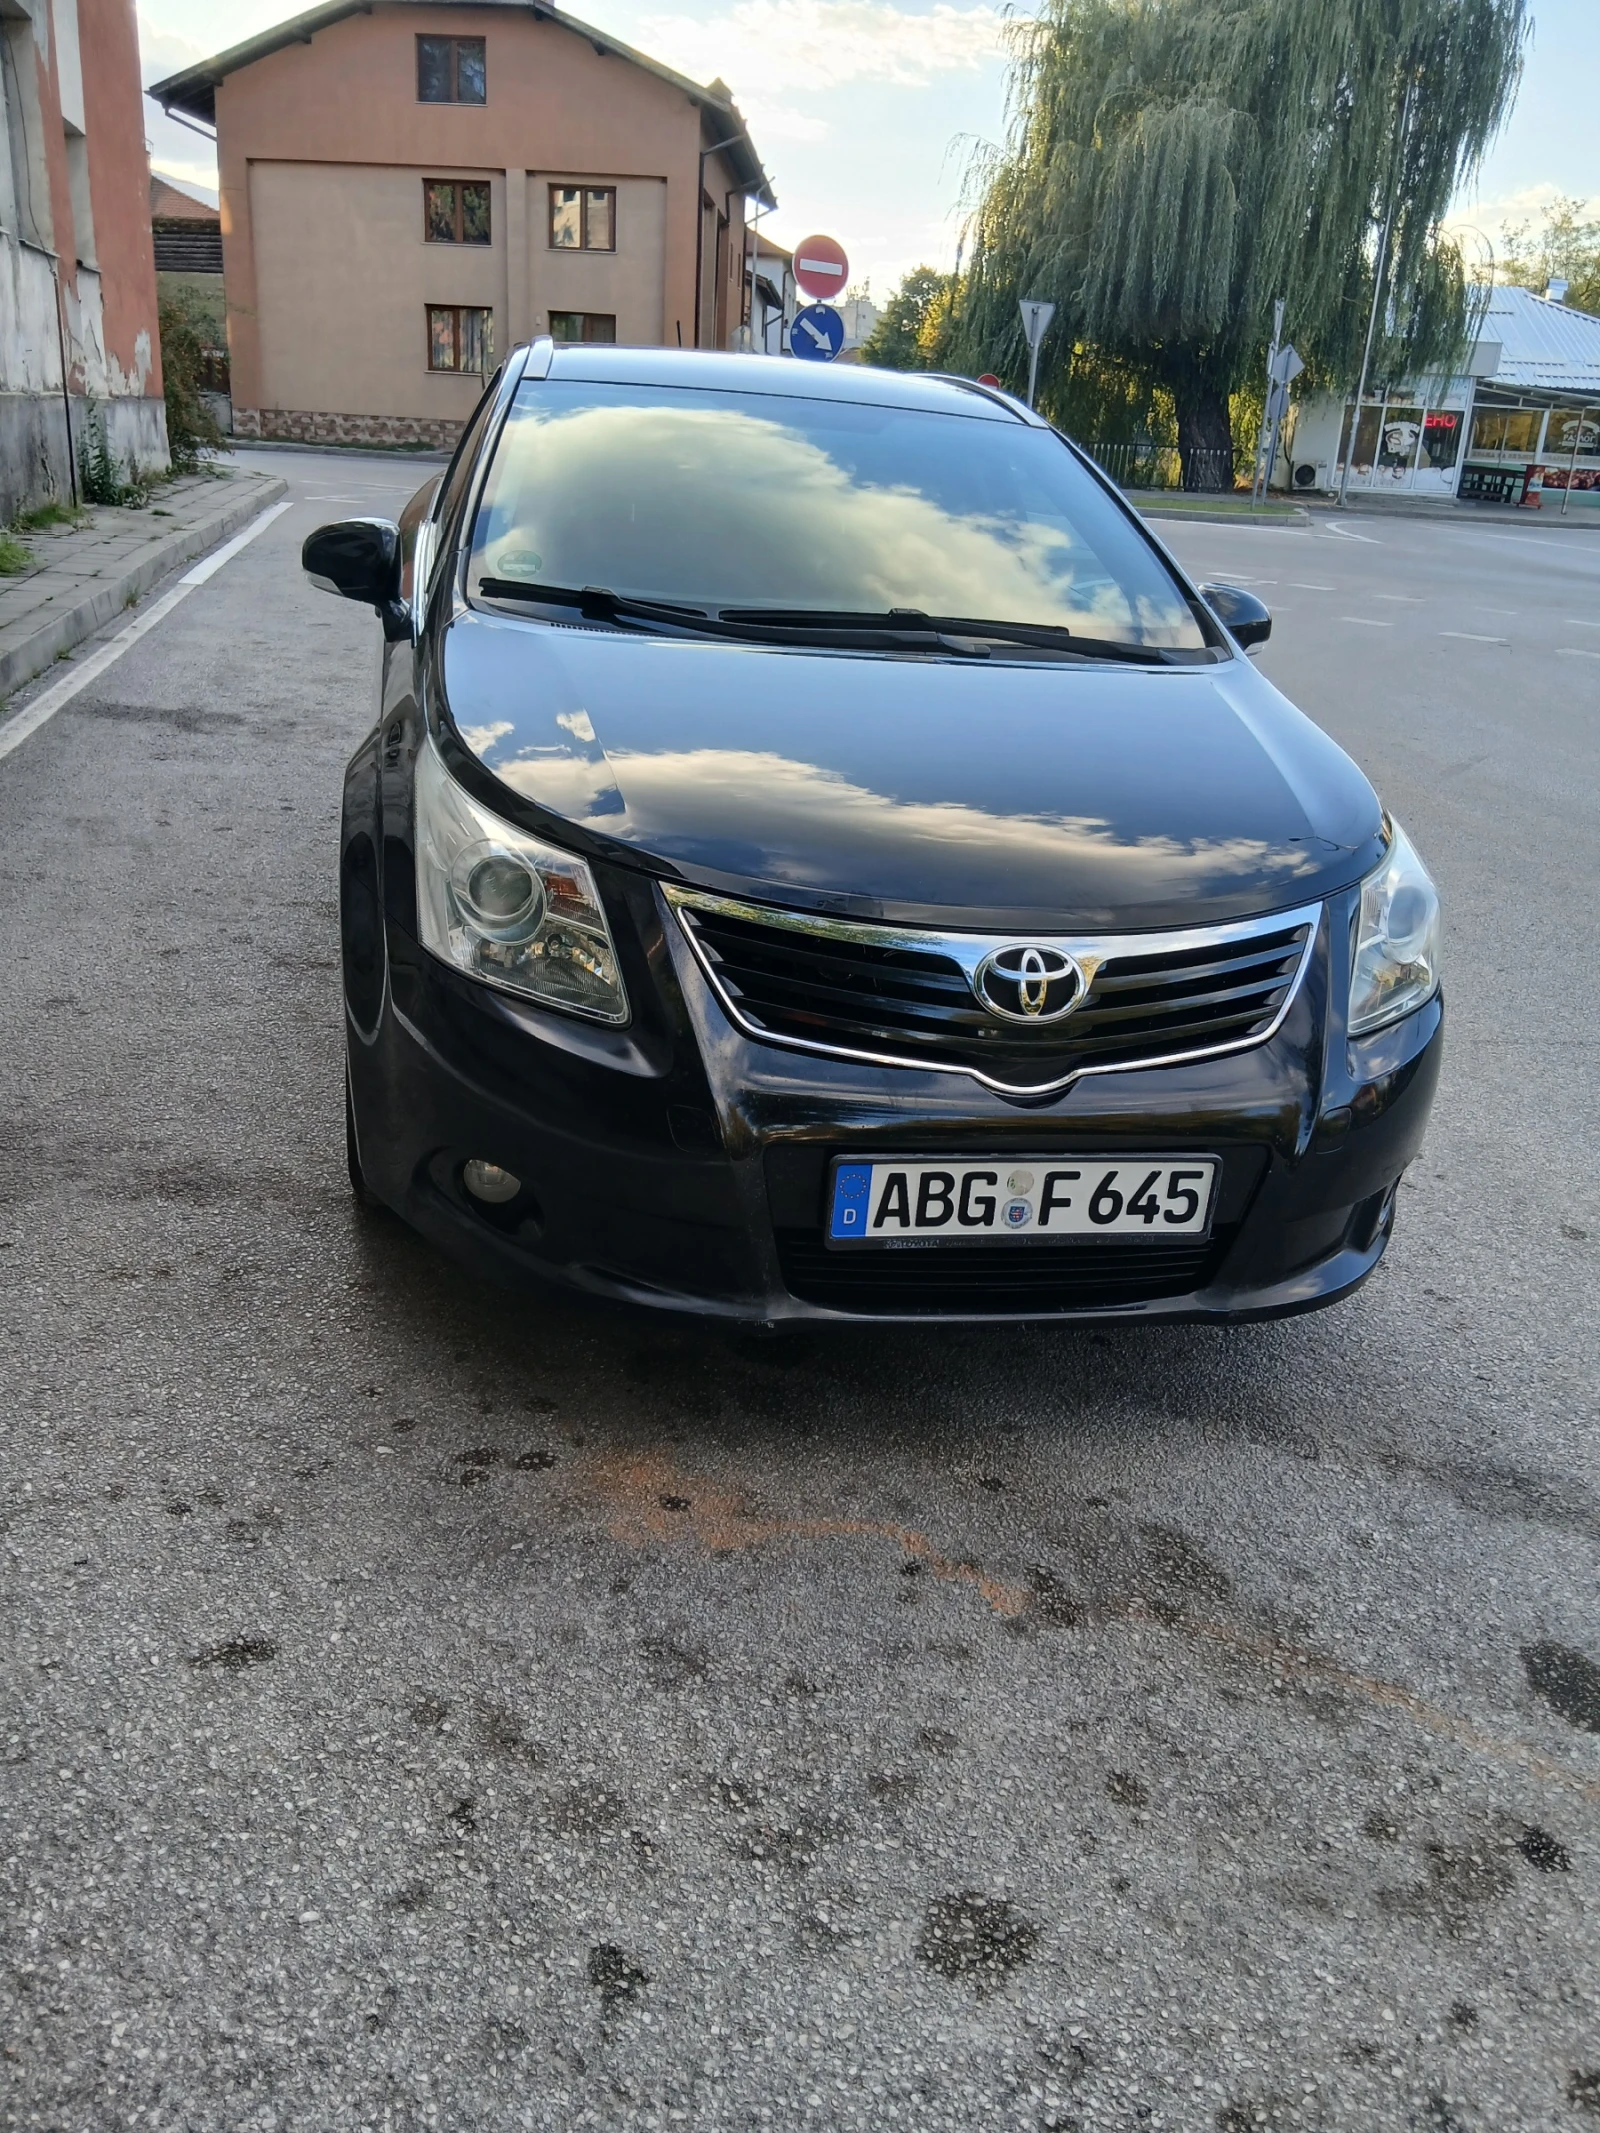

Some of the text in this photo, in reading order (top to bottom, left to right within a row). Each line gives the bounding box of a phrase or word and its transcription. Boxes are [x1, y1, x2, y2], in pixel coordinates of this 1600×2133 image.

[1563, 433, 1596, 443] РАЛОГ
[872, 1170, 1204, 1228] ABG F 645
[843, 1209, 857, 1225] D
